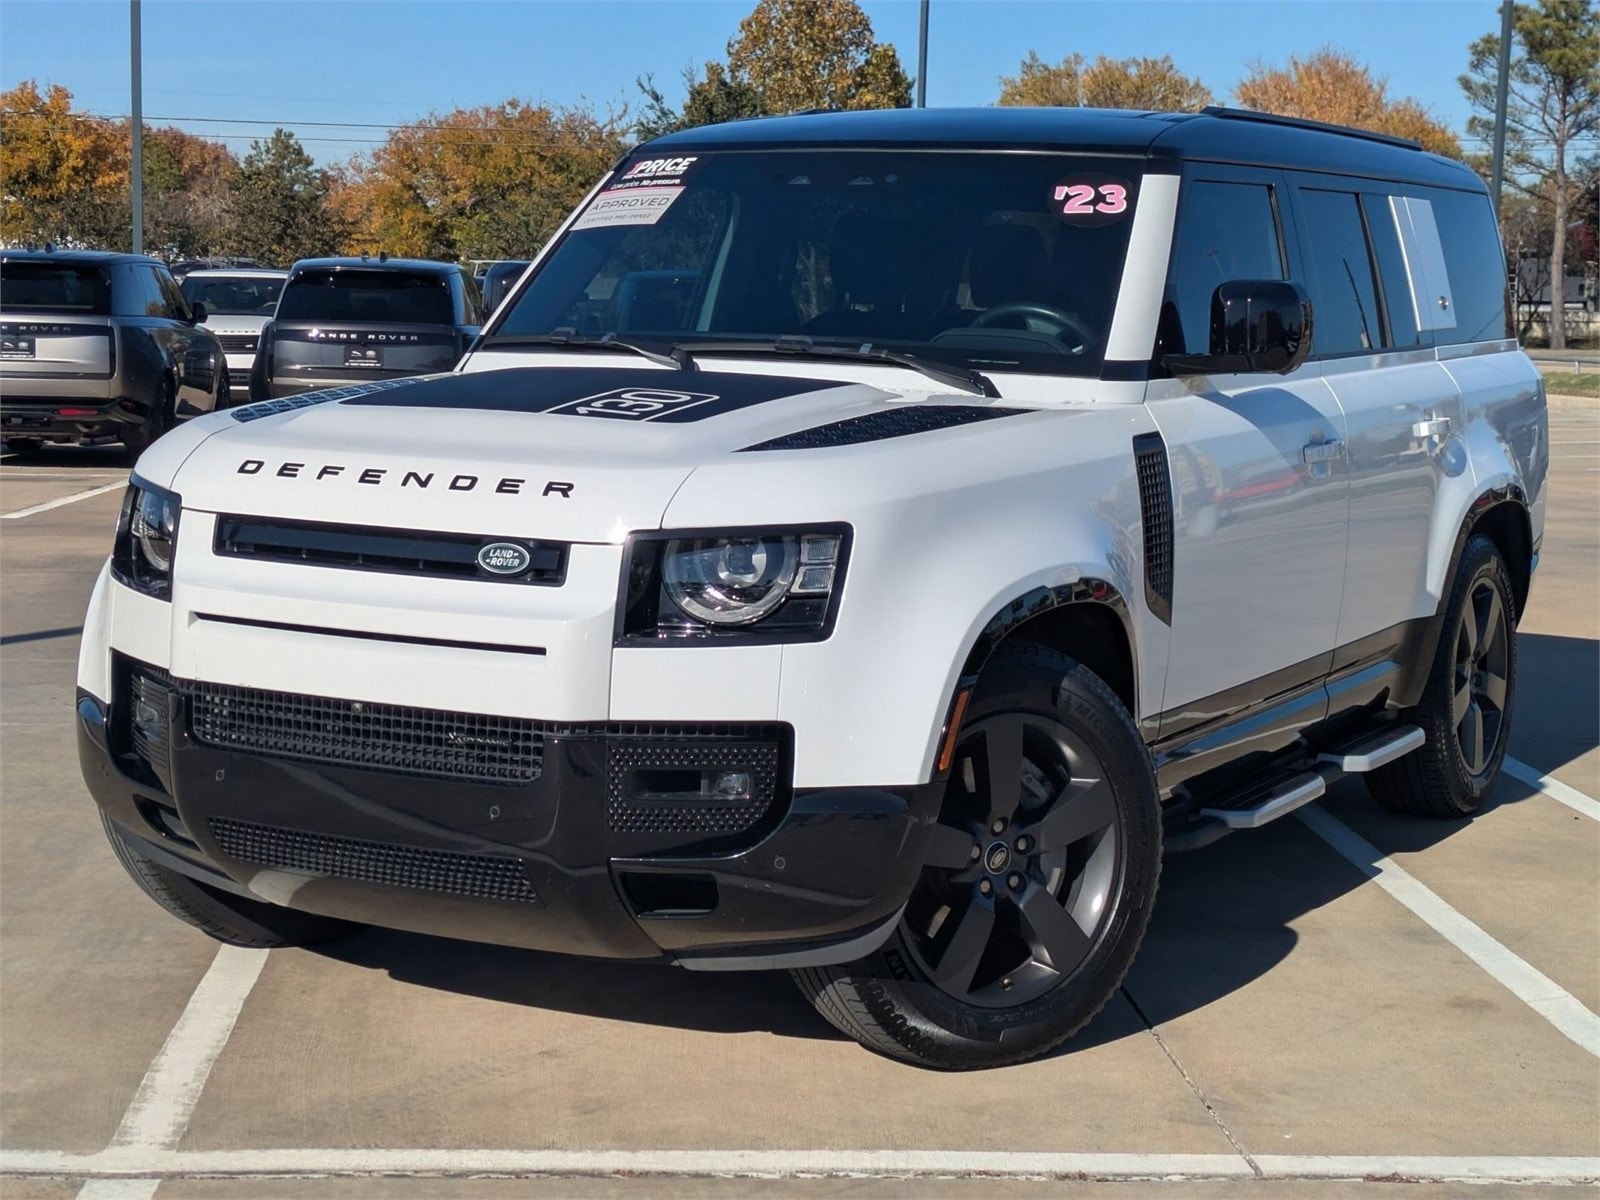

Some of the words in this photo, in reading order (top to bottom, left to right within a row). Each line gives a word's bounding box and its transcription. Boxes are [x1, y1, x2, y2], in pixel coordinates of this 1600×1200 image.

[591, 198, 670, 211] APPROVED
[1054, 184, 1127, 214] '23
[576, 391, 691, 416] 130
[237, 459, 575, 498] DEFENDER
